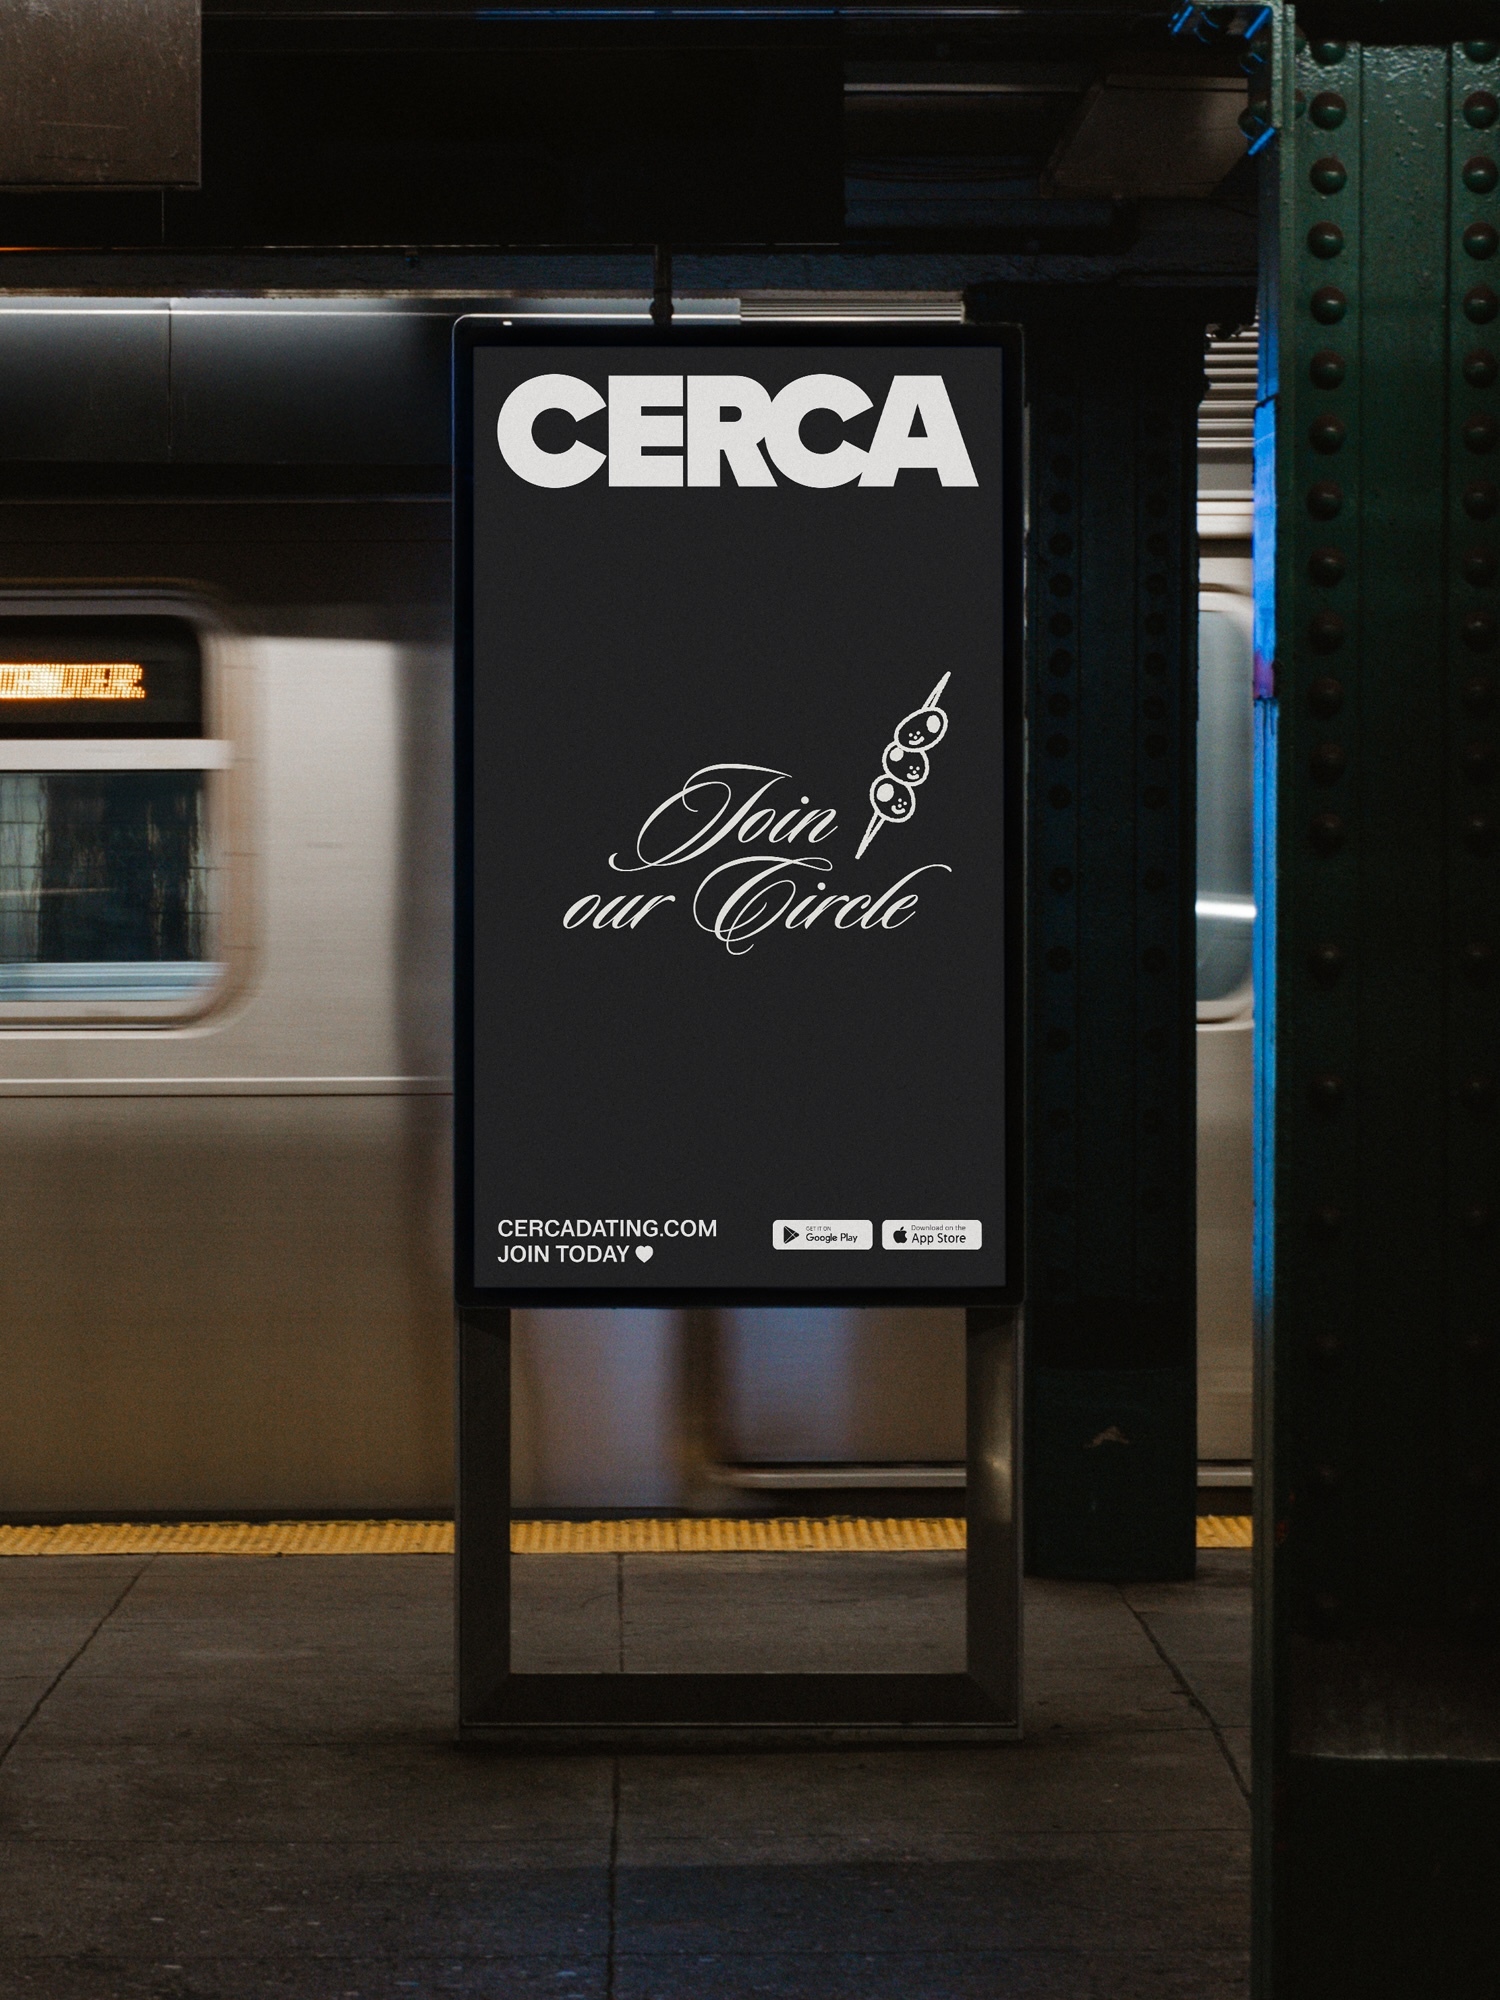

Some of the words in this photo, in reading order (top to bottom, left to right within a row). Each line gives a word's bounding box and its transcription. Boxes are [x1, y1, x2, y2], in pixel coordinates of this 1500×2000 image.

[496, 373, 979, 489] CERCA
[608, 763, 838, 872] Join
[563, 894, 676, 930] our
[692, 855, 952, 956] Circle
[497, 1219, 717, 1238] CERCADATING.COM
[805, 1232, 838, 1244] Google
[840, 1232, 858, 1243] Play
[911, 1232, 934, 1246] App
[936, 1232, 967, 1244] Store
[497, 1244, 550, 1263] JOIN
[555, 1244, 630, 1263] TODAY
